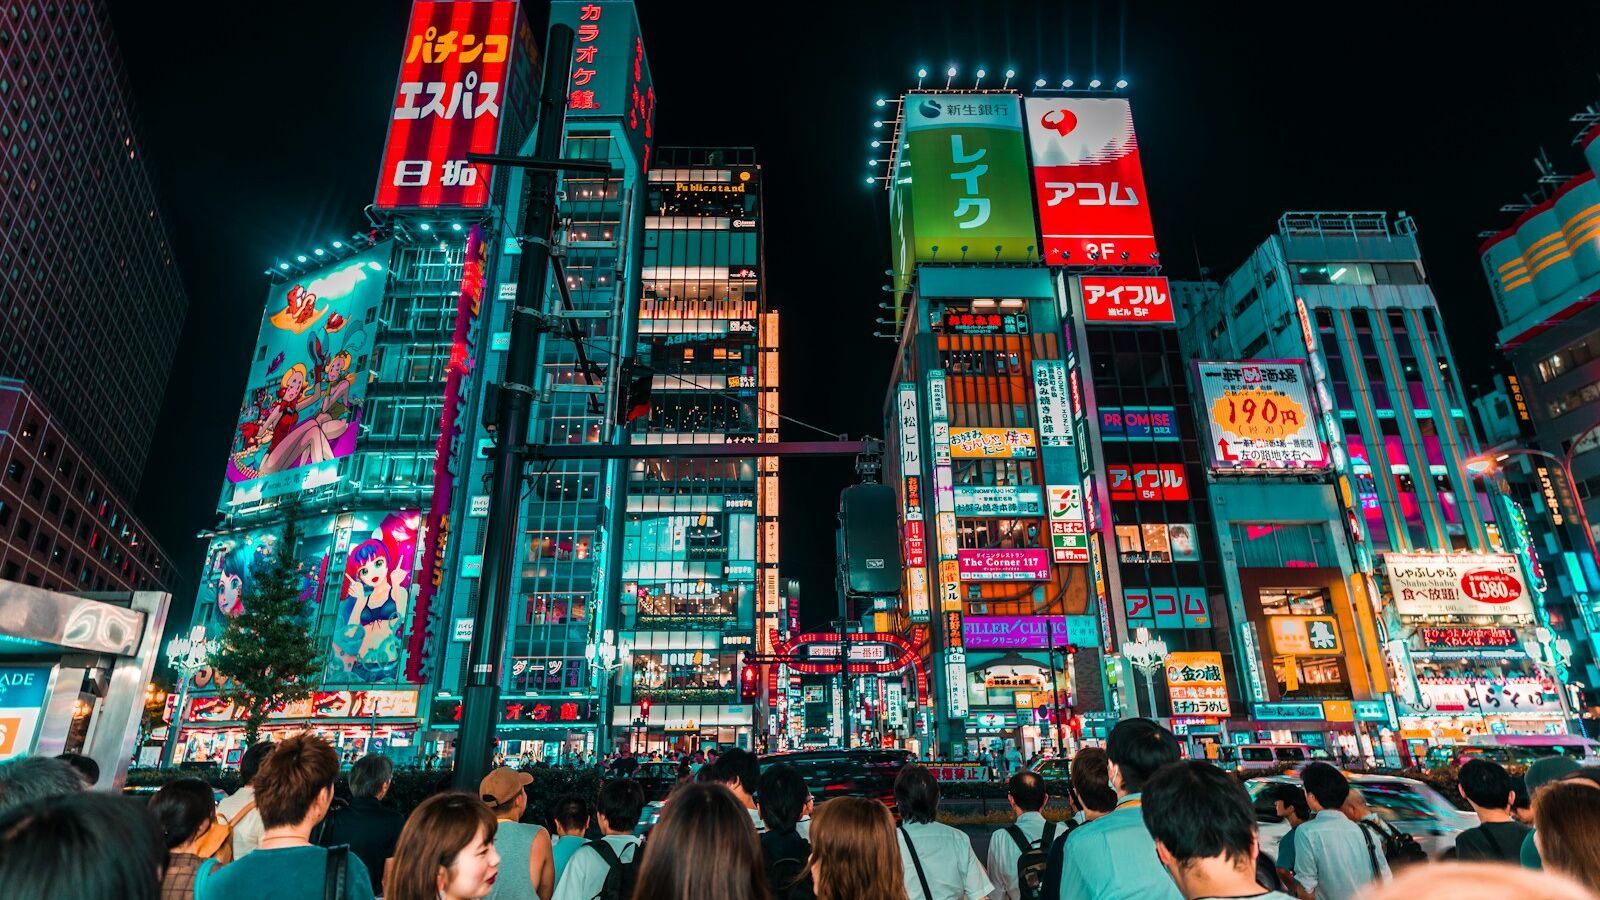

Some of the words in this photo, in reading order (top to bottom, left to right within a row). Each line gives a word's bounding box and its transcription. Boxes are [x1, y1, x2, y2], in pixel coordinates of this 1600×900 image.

[405, 26, 509, 63] パチンコ
[570, 4, 602, 110] カラオケ館
[393, 70, 500, 120] エスパス
[946, 104, 1009, 117] 新生銀行
[393, 159, 478, 187] 日拓
[950, 134, 992, 229] レイク
[1044, 181, 1139, 207] アコム
[1085, 242, 1115, 261] 3F
[1084, 285, 1167, 305] アイフル
[1104, 413, 1170, 426] PROMISE
[1228, 398, 1299, 425] 190円
[903, 398, 918, 462] 小松ビル
[1241, 449, 1312, 461] 左の路地を右へ
[1109, 469, 1184, 488] アイフル
[1053, 522, 1083, 533] たばこ
[963, 558, 983, 566] The
[986, 558, 1020, 566] Corner
[1023, 558, 1039, 566] 117
[1393, 567, 1457, 578] しゃぶしゃぶ
[1402, 588, 1460, 601] 食べ放題!
[1469, 580, 1508, 600] 1,980
[1126, 594, 1206, 616] アコム
[963, 622, 1010, 634] FILLER
[512, 660, 563, 676] ダーツ
[1181, 665, 1222, 681] 金の蔵
[1180, 700, 1228, 714] チカラめし
